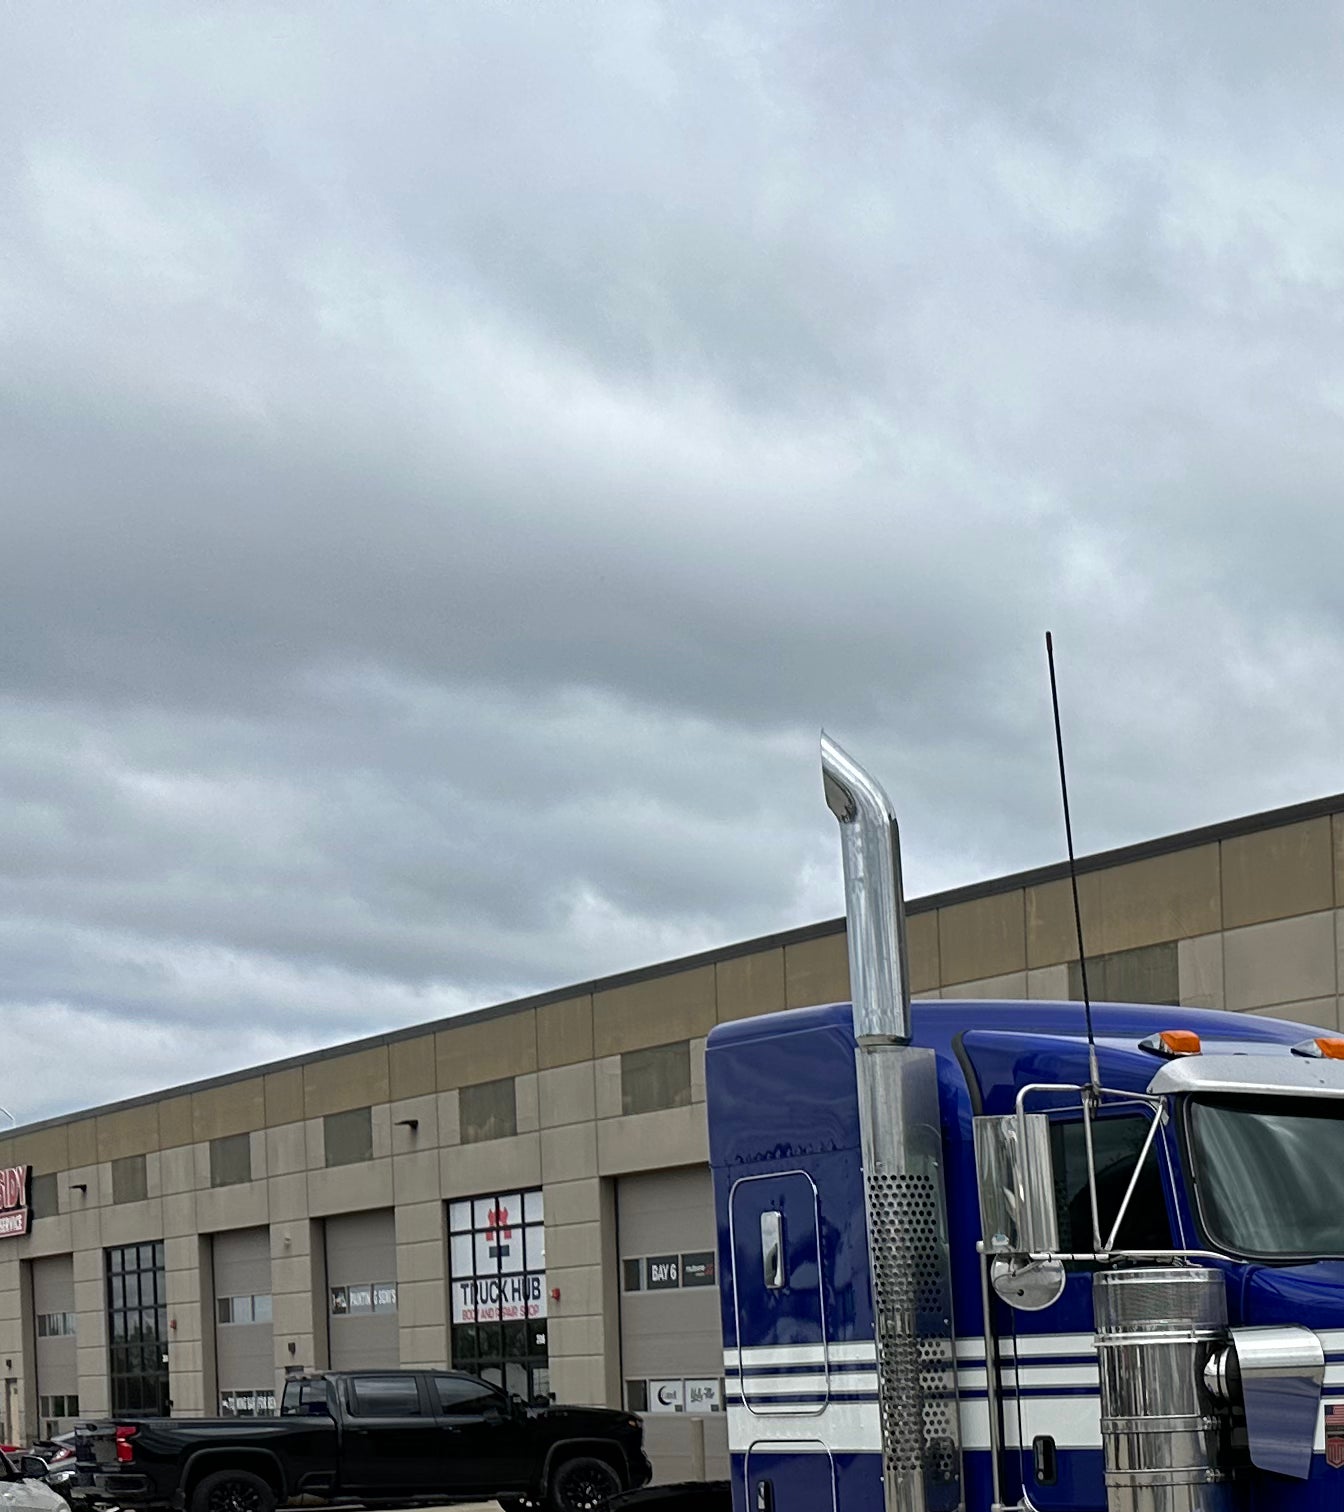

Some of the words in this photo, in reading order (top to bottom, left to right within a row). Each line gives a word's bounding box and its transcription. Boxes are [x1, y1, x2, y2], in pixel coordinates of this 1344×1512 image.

[651, 1264, 669, 1281] BAY
[670, 1263, 677, 1280] 6
[460, 1279, 509, 1306] TRUCK
[511, 1277, 541, 1302] HUB
[495, 1305, 518, 1318] RPAIR
